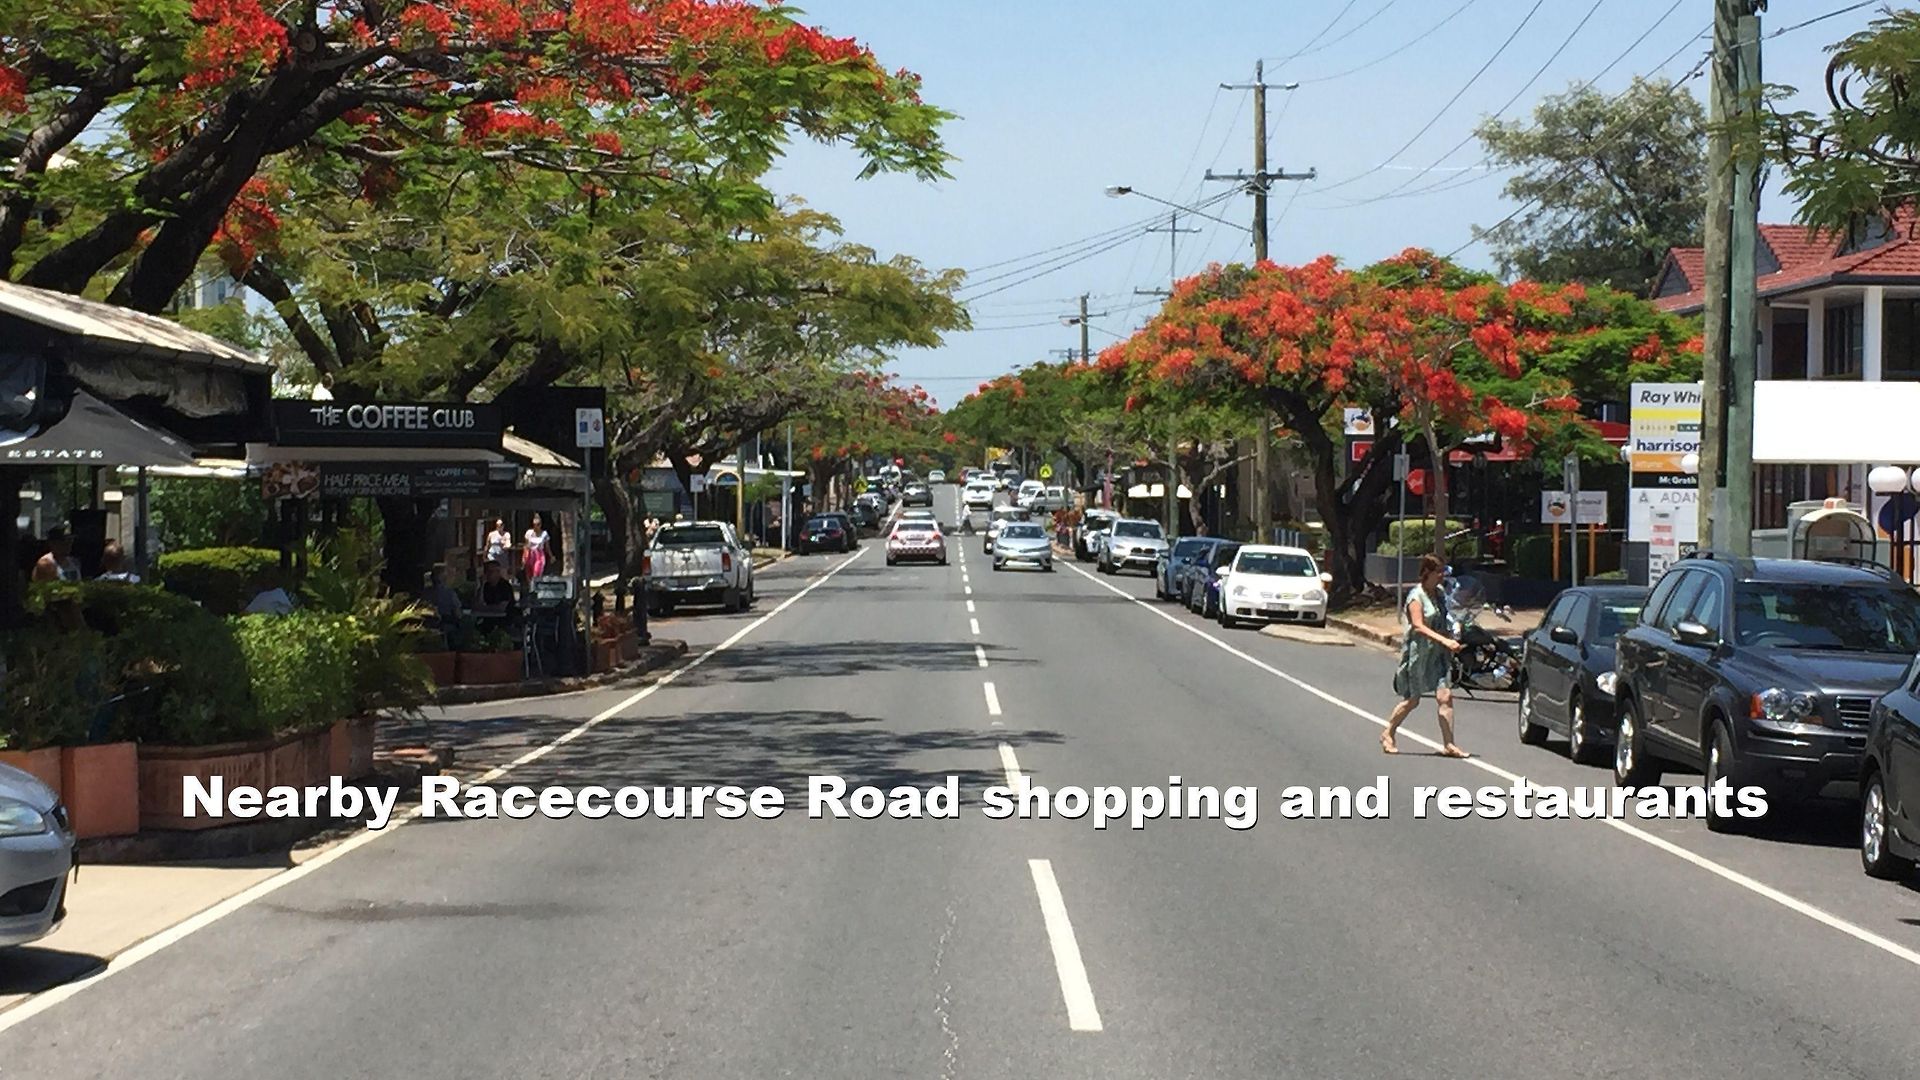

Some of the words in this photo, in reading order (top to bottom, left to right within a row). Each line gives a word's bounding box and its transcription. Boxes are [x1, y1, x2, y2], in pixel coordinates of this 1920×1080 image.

[1640, 390, 1670, 405] Ray
[310, 406, 343, 426] THE
[347, 404, 429, 429] COFFEE
[432, 408, 474, 428] CLUB
[7, 449, 103, 458] ESTATE
[324, 473, 351, 487] HALF
[352, 473, 382, 487] PRICE
[383, 473, 410, 487] MEAL
